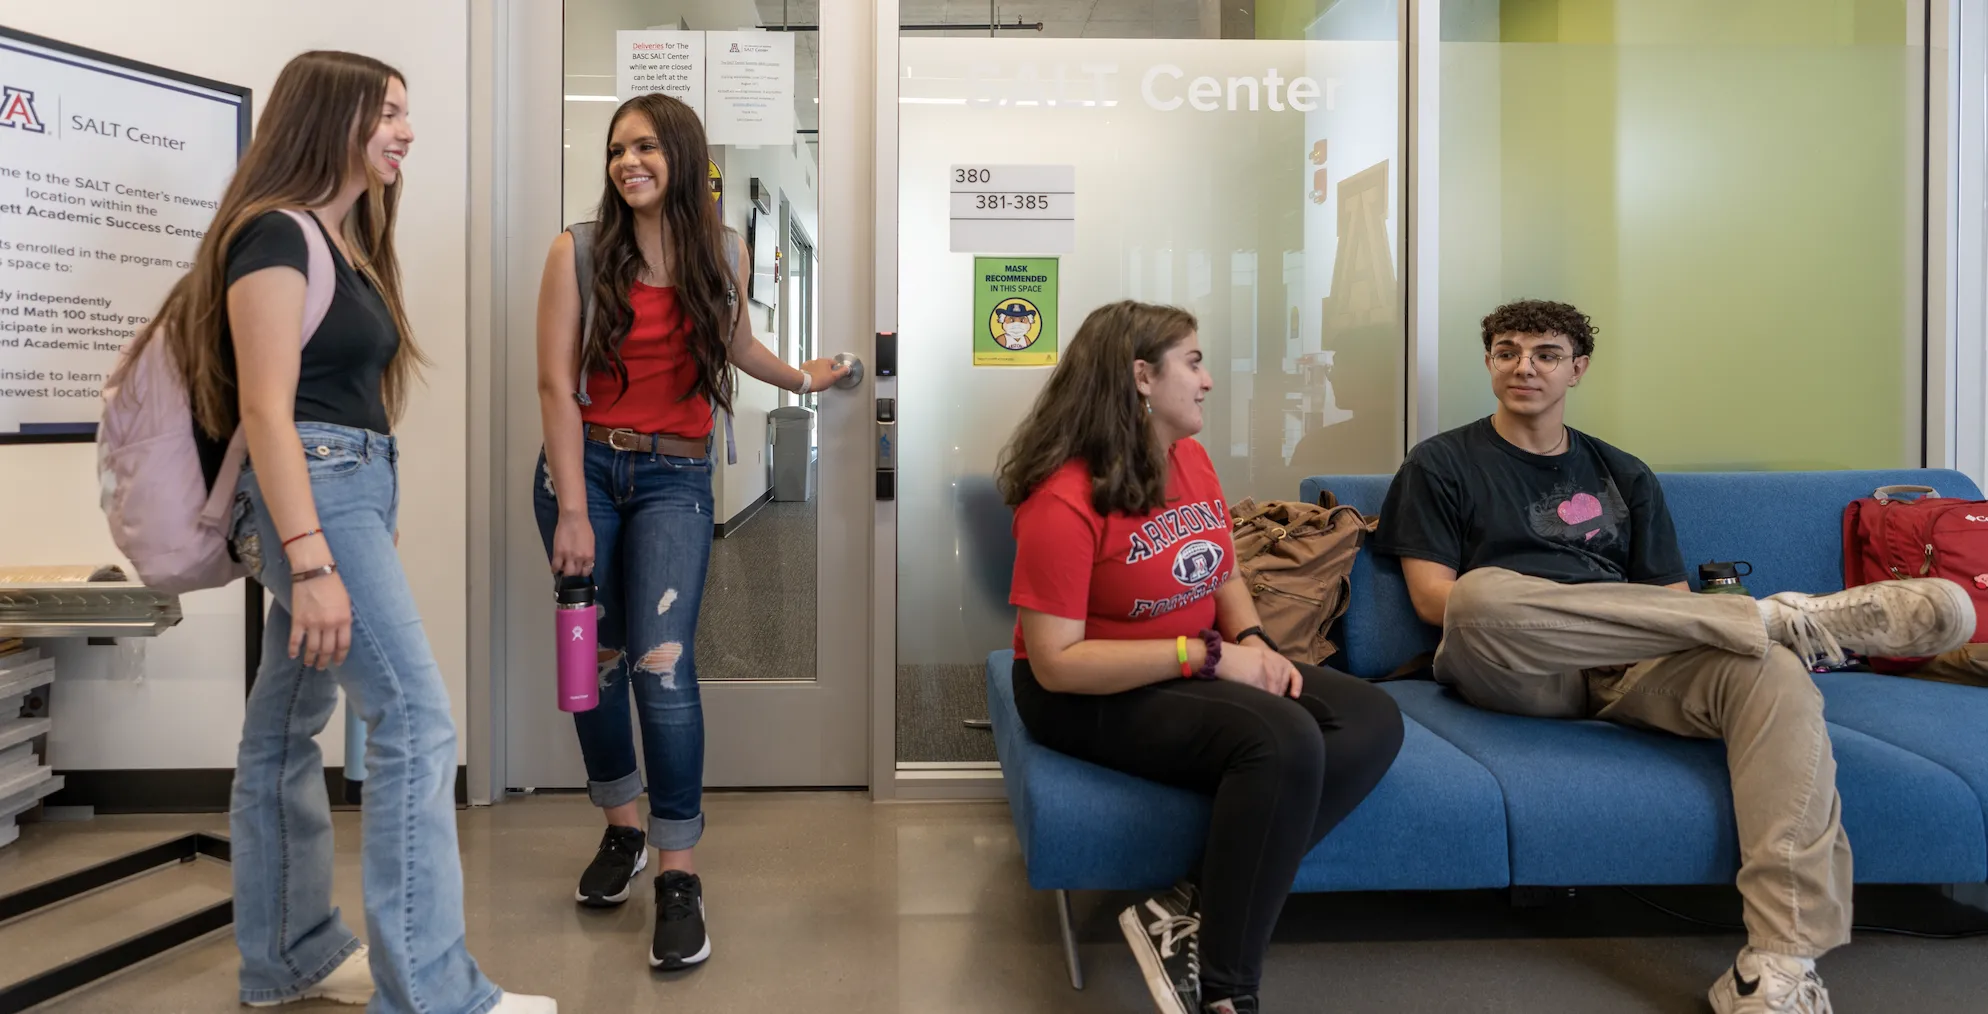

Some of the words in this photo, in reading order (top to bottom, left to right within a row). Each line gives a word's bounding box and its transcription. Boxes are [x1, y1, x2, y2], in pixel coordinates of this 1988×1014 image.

[1141, 64, 1344, 112] Center
[72, 115, 121, 138] SALT
[126, 127, 186, 151] Center
[955, 169, 991, 183] 380
[26, 170, 41, 181] to
[46, 173, 70, 186] the
[75, 177, 110, 192] SALT
[115, 184, 170, 202] Center's
[174, 195, 218, 210] newest
[26, 187, 86, 205] location
[90, 198, 132, 212] within
[136, 204, 158, 216] the
[976, 195, 1049, 210] 381-385
[27, 205, 102, 225] Academic
[106, 216, 161, 233] Success
[16, 243, 75, 257] enrolled
[79, 247, 91, 258] in
[95, 250, 117, 261] the
[120, 254, 173, 267] program
[8, 259, 51, 270] space
[55, 262, 73, 273] to:
[1018, 285, 1042, 293] SPACE
[17, 290, 112, 309] independently
[0, 306, 19, 316] nd
[24, 307, 59, 318] Math
[63, 309, 86, 320] 100
[90, 312, 124, 325] study
[0, 321, 48, 334] icipate
[51, 325, 63, 334] in
[67, 327, 136, 340] workshops
[0, 338, 20, 348] nd
[24, 338, 90, 350] Academic
[1, 369, 45, 381] inside
[49, 371, 63, 381] to
[68, 370, 102, 381] learn
